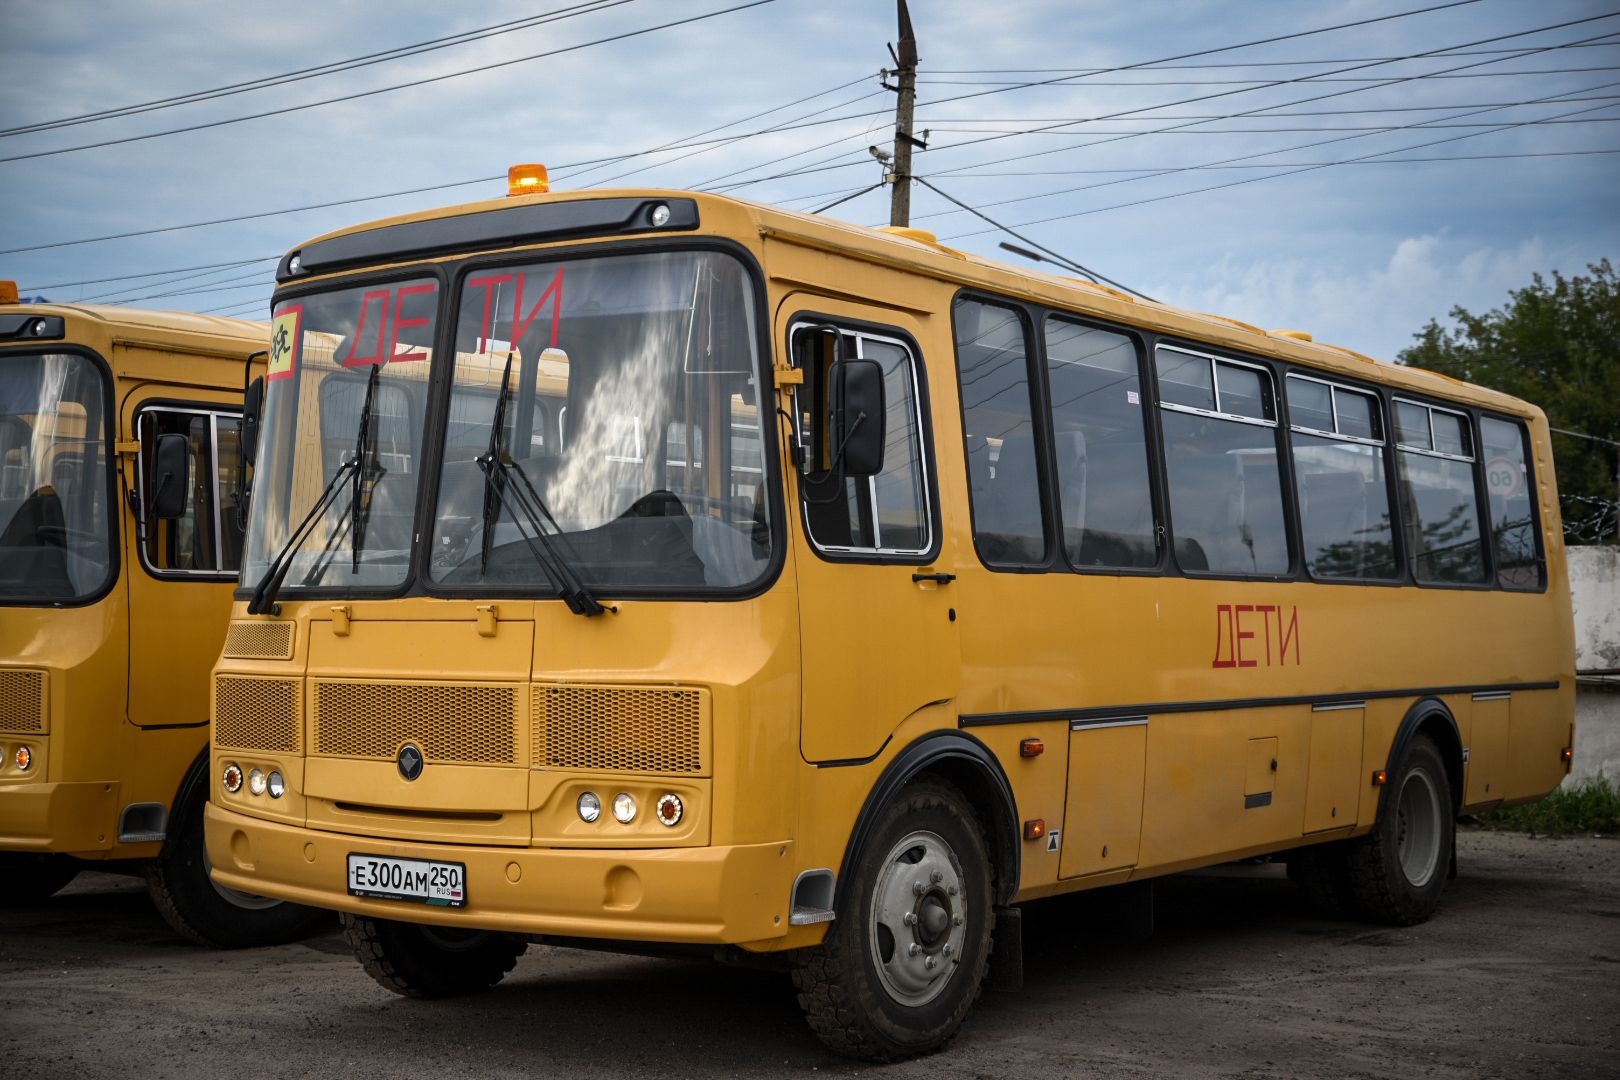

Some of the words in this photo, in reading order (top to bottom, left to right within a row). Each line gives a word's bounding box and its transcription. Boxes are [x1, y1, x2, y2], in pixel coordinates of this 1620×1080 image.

[342, 267, 564, 367] ДЕТИ
[1212, 605, 1300, 668] ДЕТИ
[430, 867, 458, 888] 250
[437, 887, 451, 896] RUS
